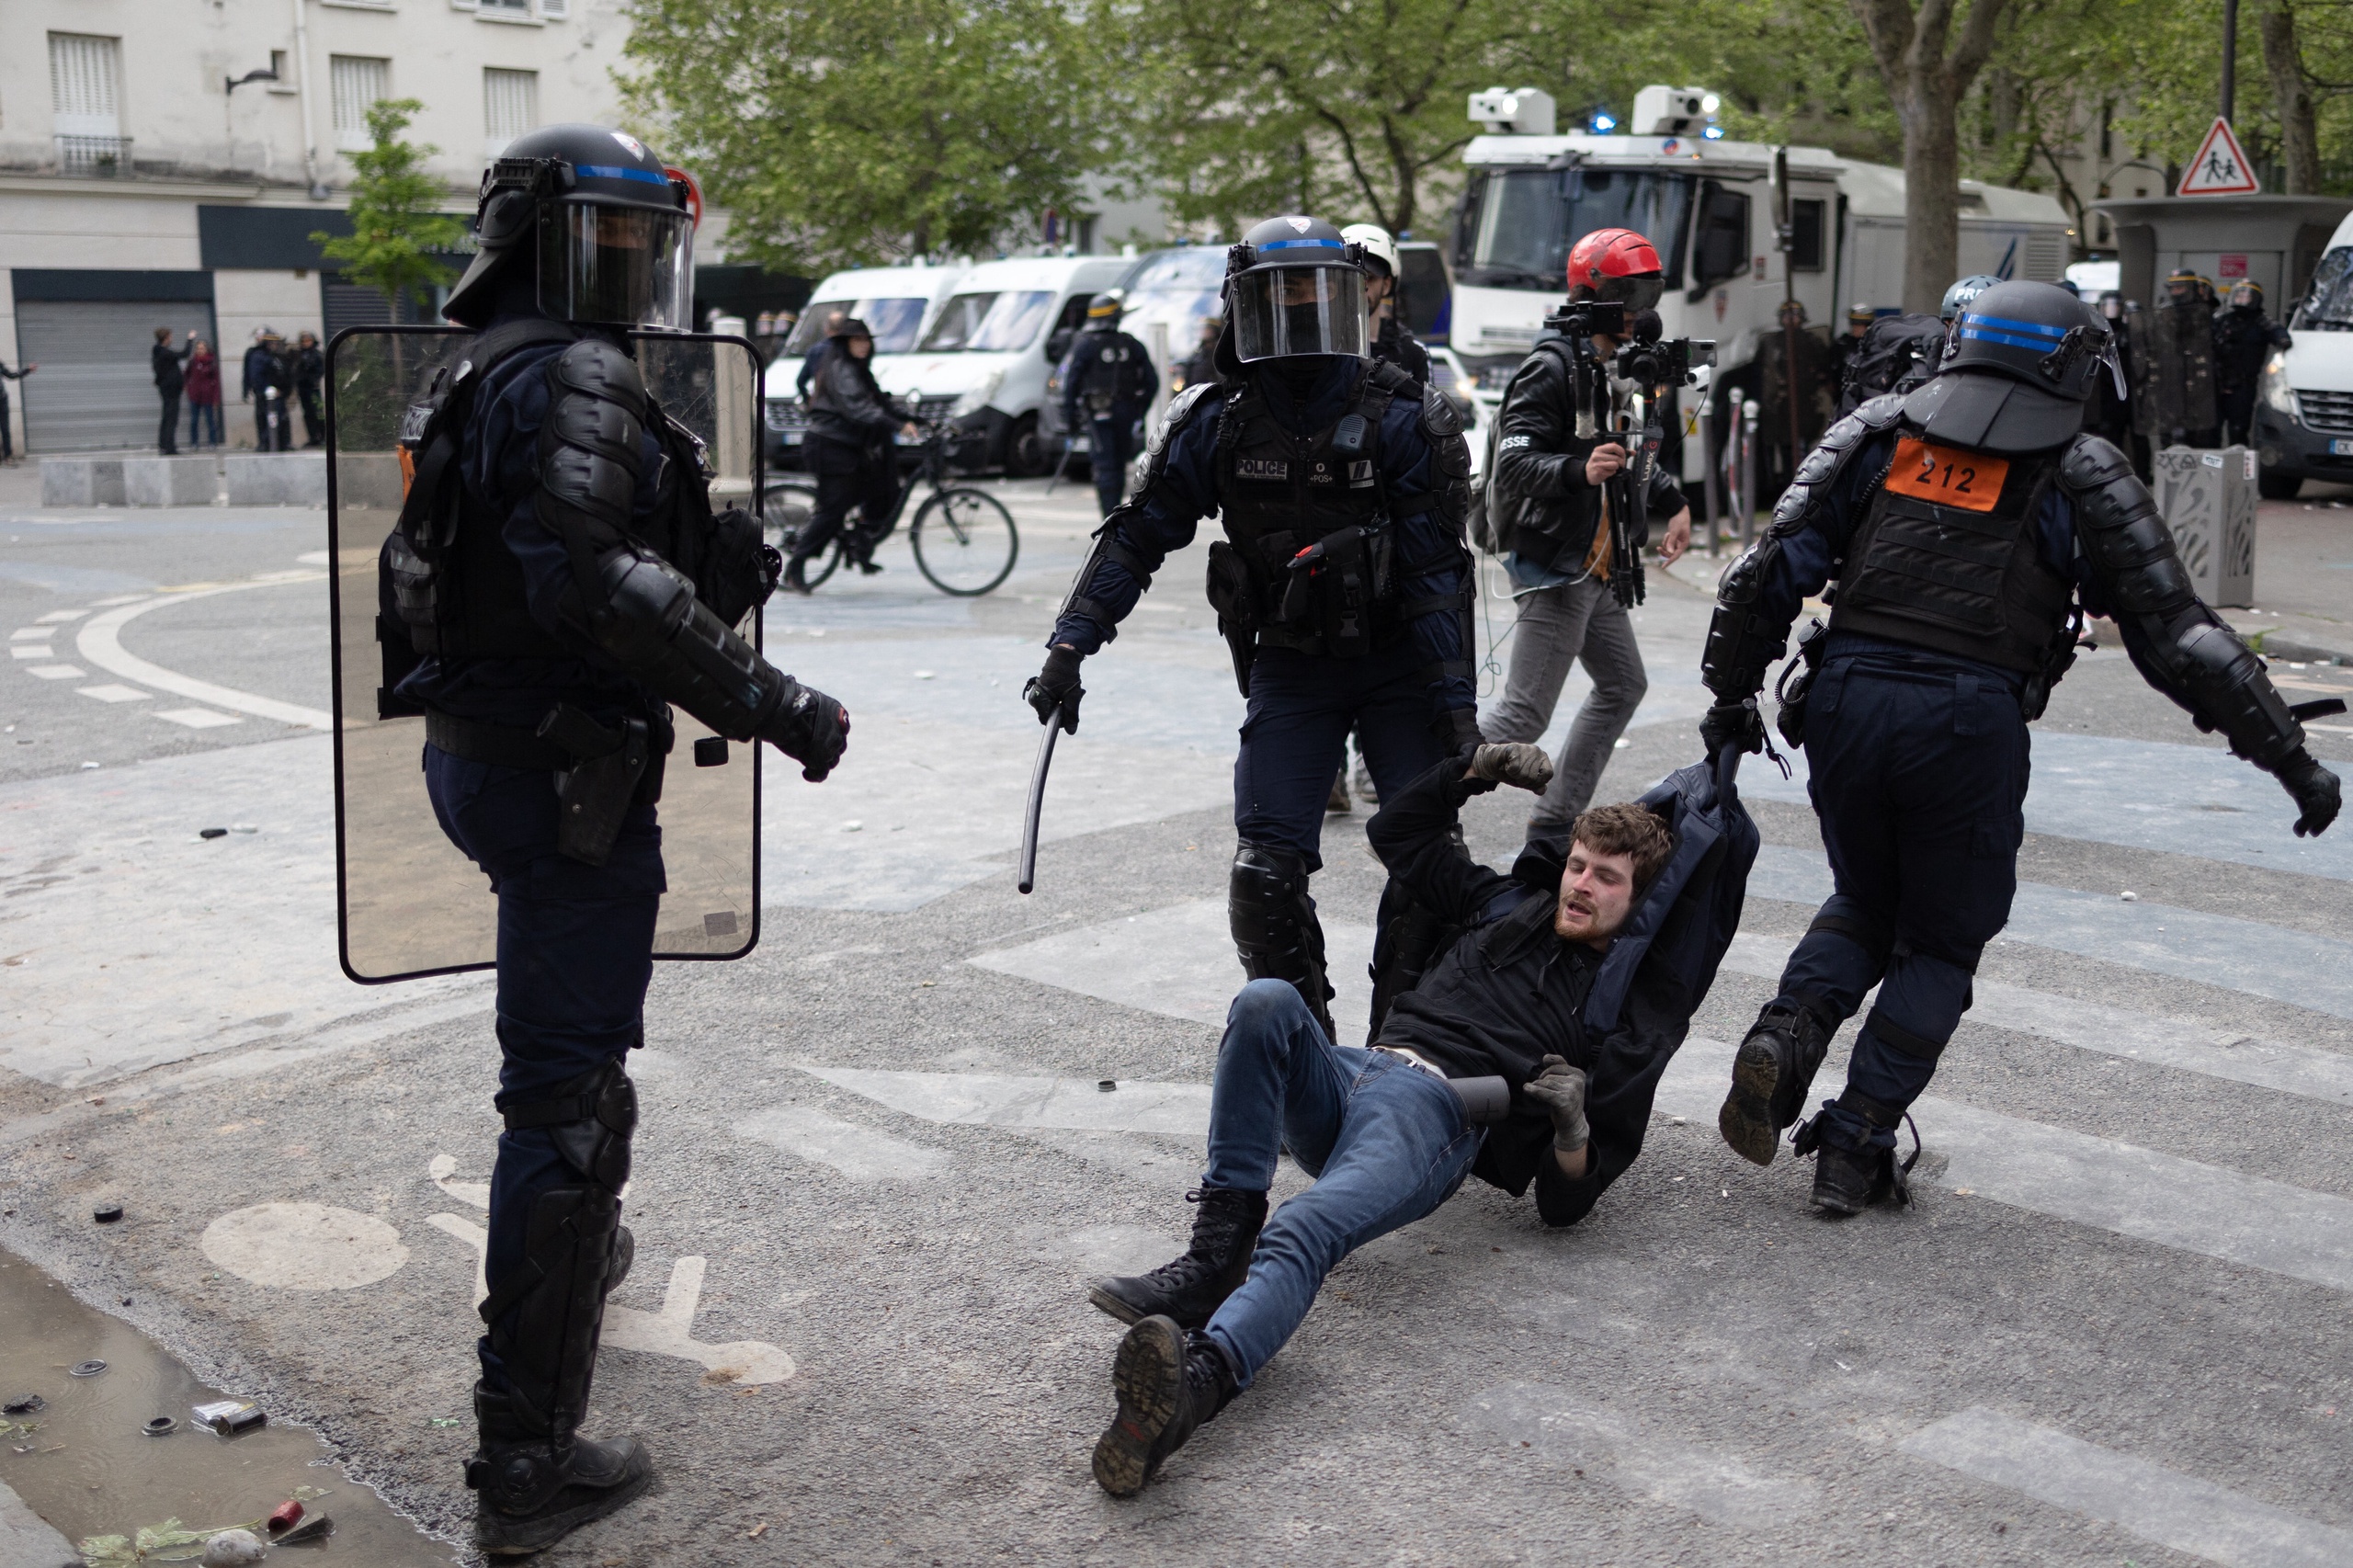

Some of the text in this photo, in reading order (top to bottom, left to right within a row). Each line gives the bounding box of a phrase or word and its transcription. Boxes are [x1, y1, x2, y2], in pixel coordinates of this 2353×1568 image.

[1500, 437, 1529, 452] ESSE
[1237, 460, 1286, 475] POLICE
[1643, 451, 1655, 482] LUMIX
[1915, 459, 1975, 494] 212
